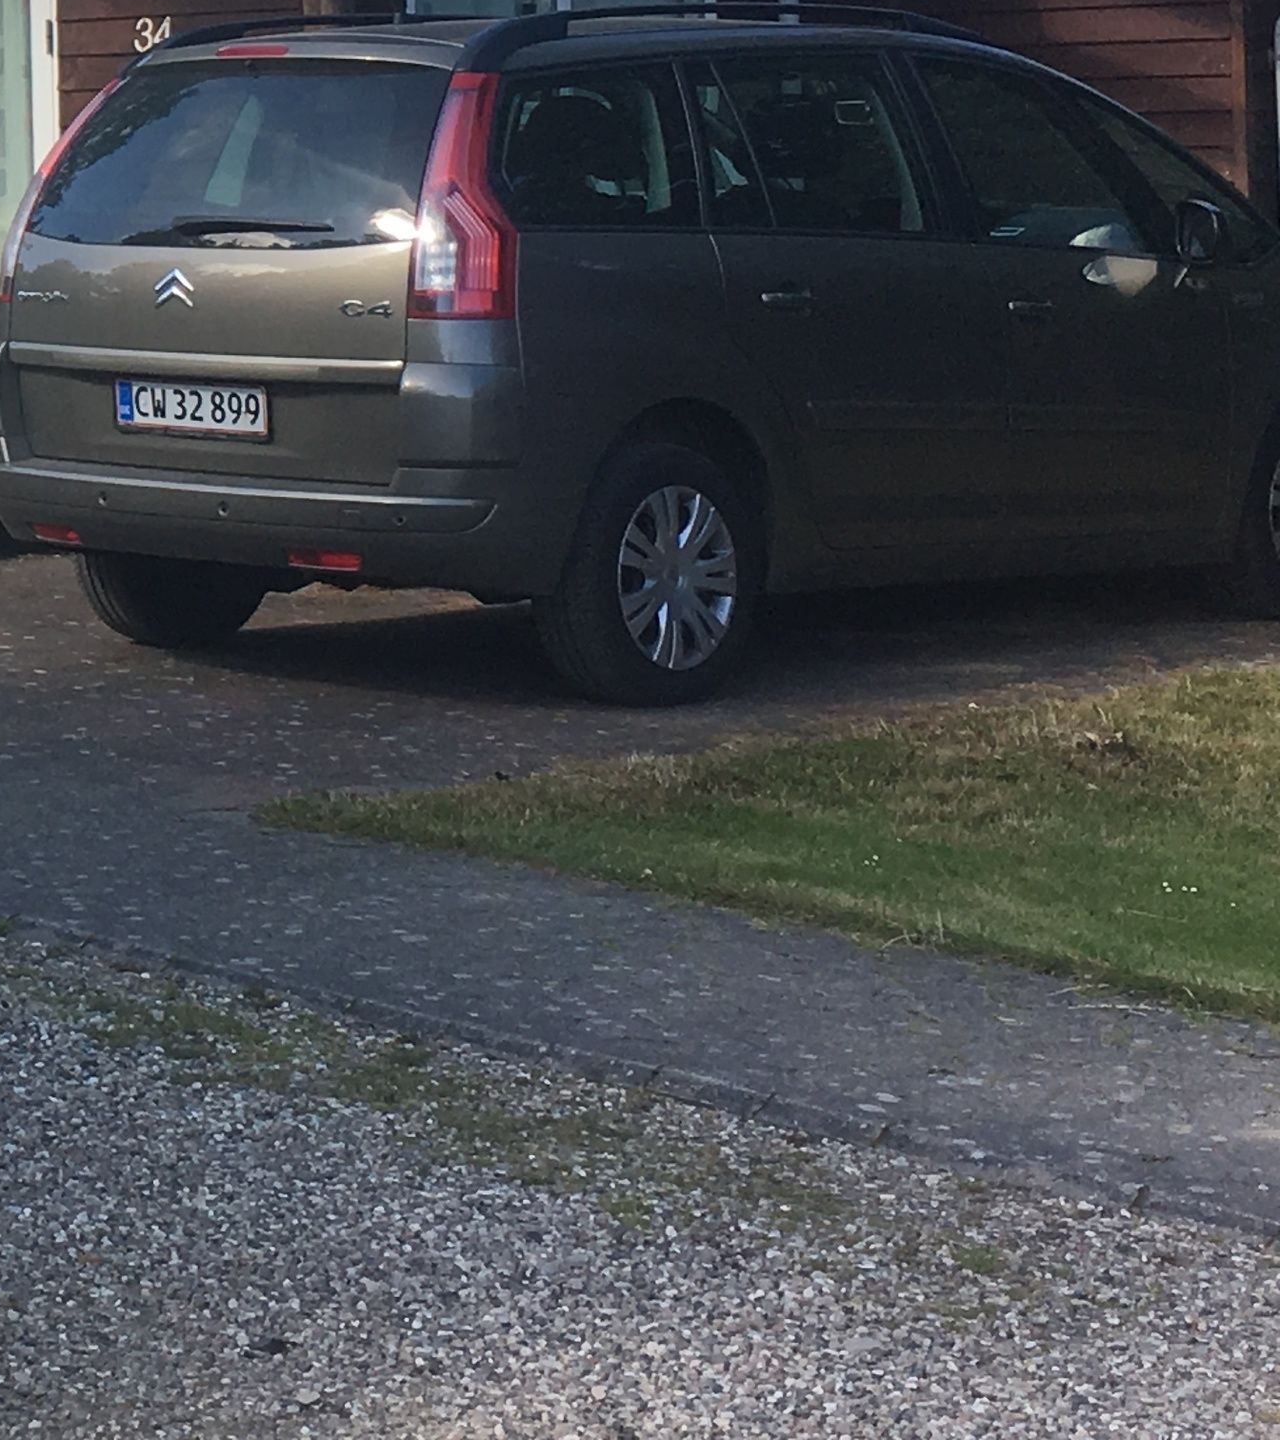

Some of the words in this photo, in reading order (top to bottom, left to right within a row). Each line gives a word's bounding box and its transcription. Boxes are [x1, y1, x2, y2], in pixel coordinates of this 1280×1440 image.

[134, 16, 171, 53] 34
[339, 300, 393, 319] C4
[134, 386, 167, 419] CW
[173, 389, 204, 422] 32
[211, 391, 260, 426] 899
